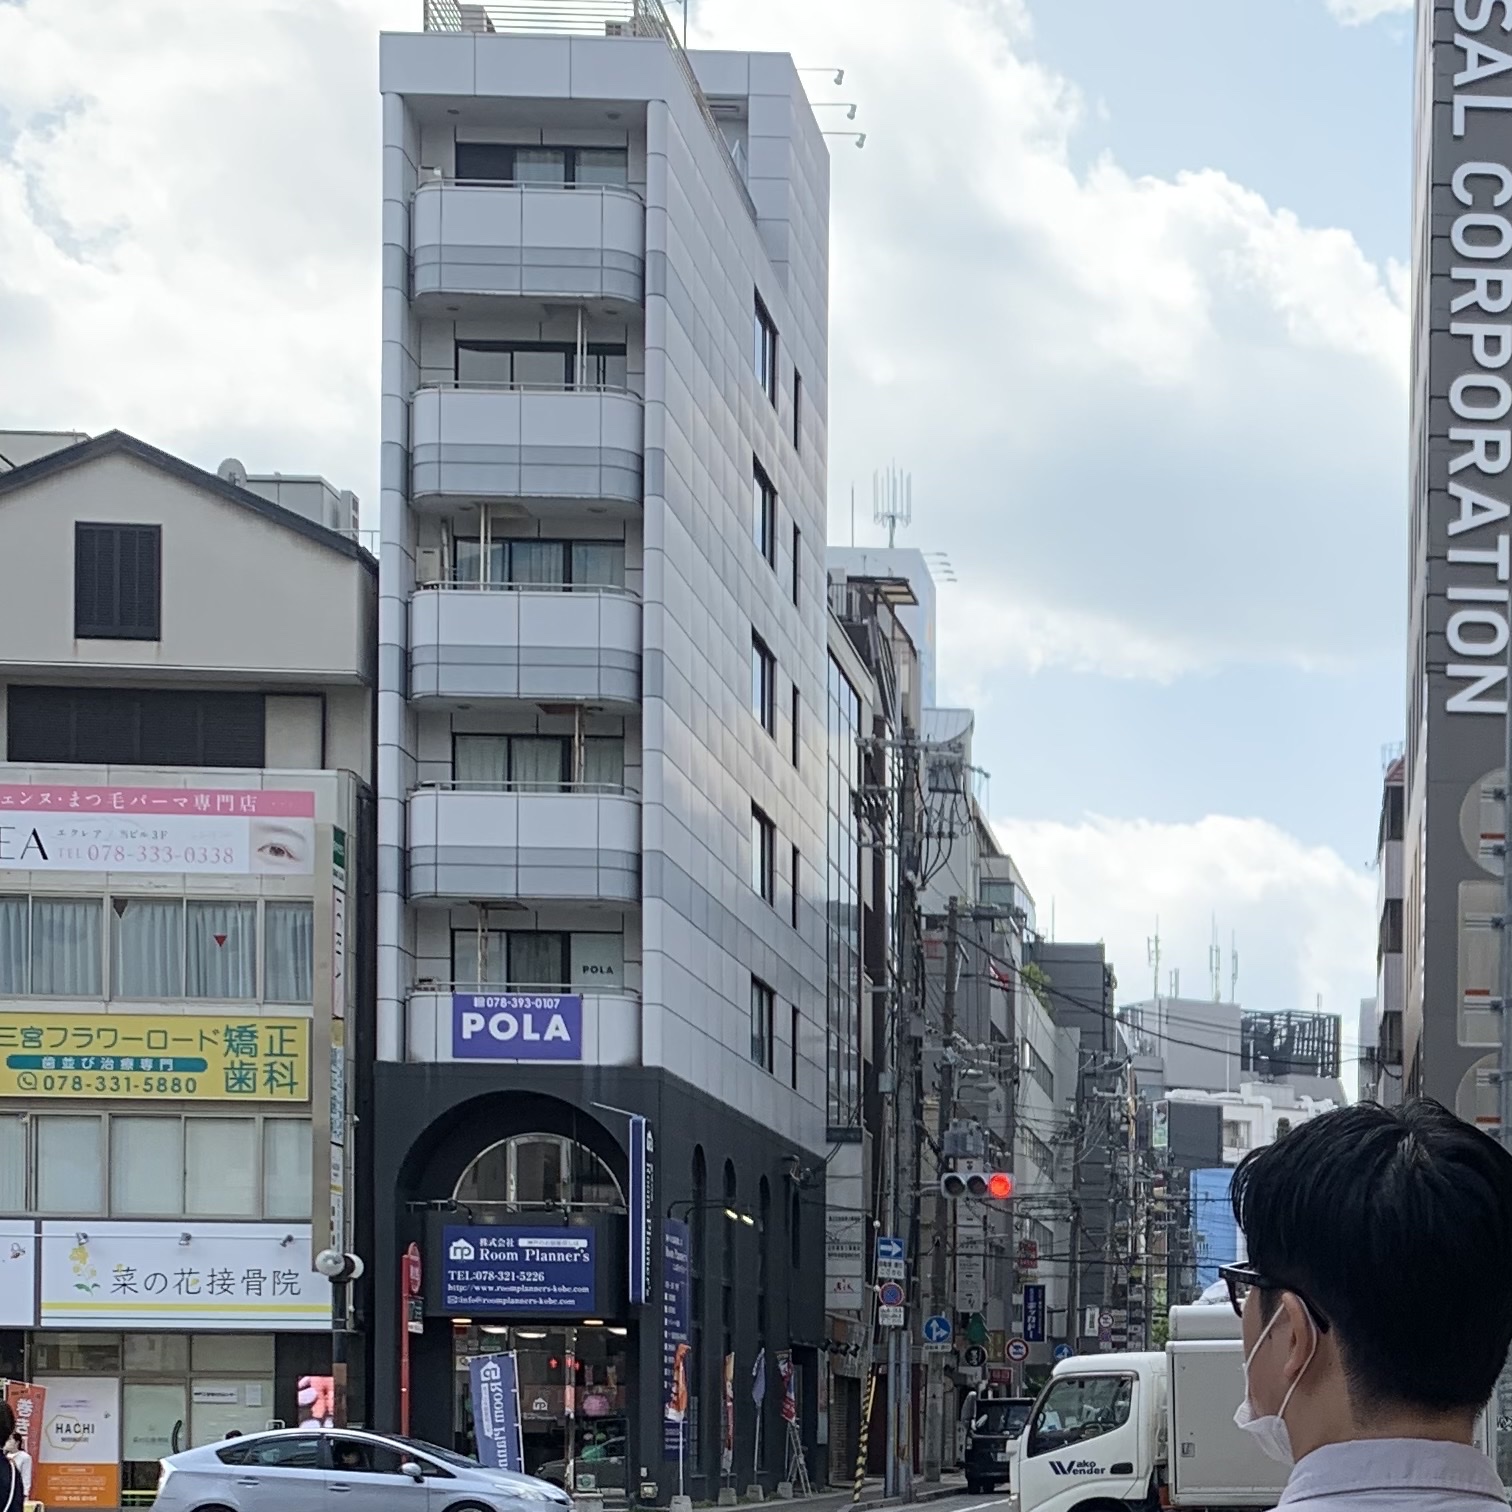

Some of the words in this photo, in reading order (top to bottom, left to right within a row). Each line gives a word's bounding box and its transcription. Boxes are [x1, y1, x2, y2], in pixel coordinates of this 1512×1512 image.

[0, 827, 49, 861] EA
[58, 848, 82, 859] TEL
[88, 845, 235, 864] 078-333-0338
[583, 965, 614, 975] POLA
[486, 997, 561, 1009] 078-393-0107
[462, 1012, 571, 1041] POLA
[0, 1025, 220, 1052] 三宮フラワーロード
[223, 1024, 299, 1058] 矯正
[42, 1056, 174, 1071] 歯並び治療専門
[43, 1075, 197, 1094] 078-331-5880
[223, 1060, 299, 1095] 歯科
[480, 1238, 514, 1247] 株式会社
[480, 1248, 519, 1261] Room
[525, 1248, 590, 1262] Planner's
[110, 1267, 301, 1296] 菜の花接骨院
[55, 1423, 95, 1434] HACHI
